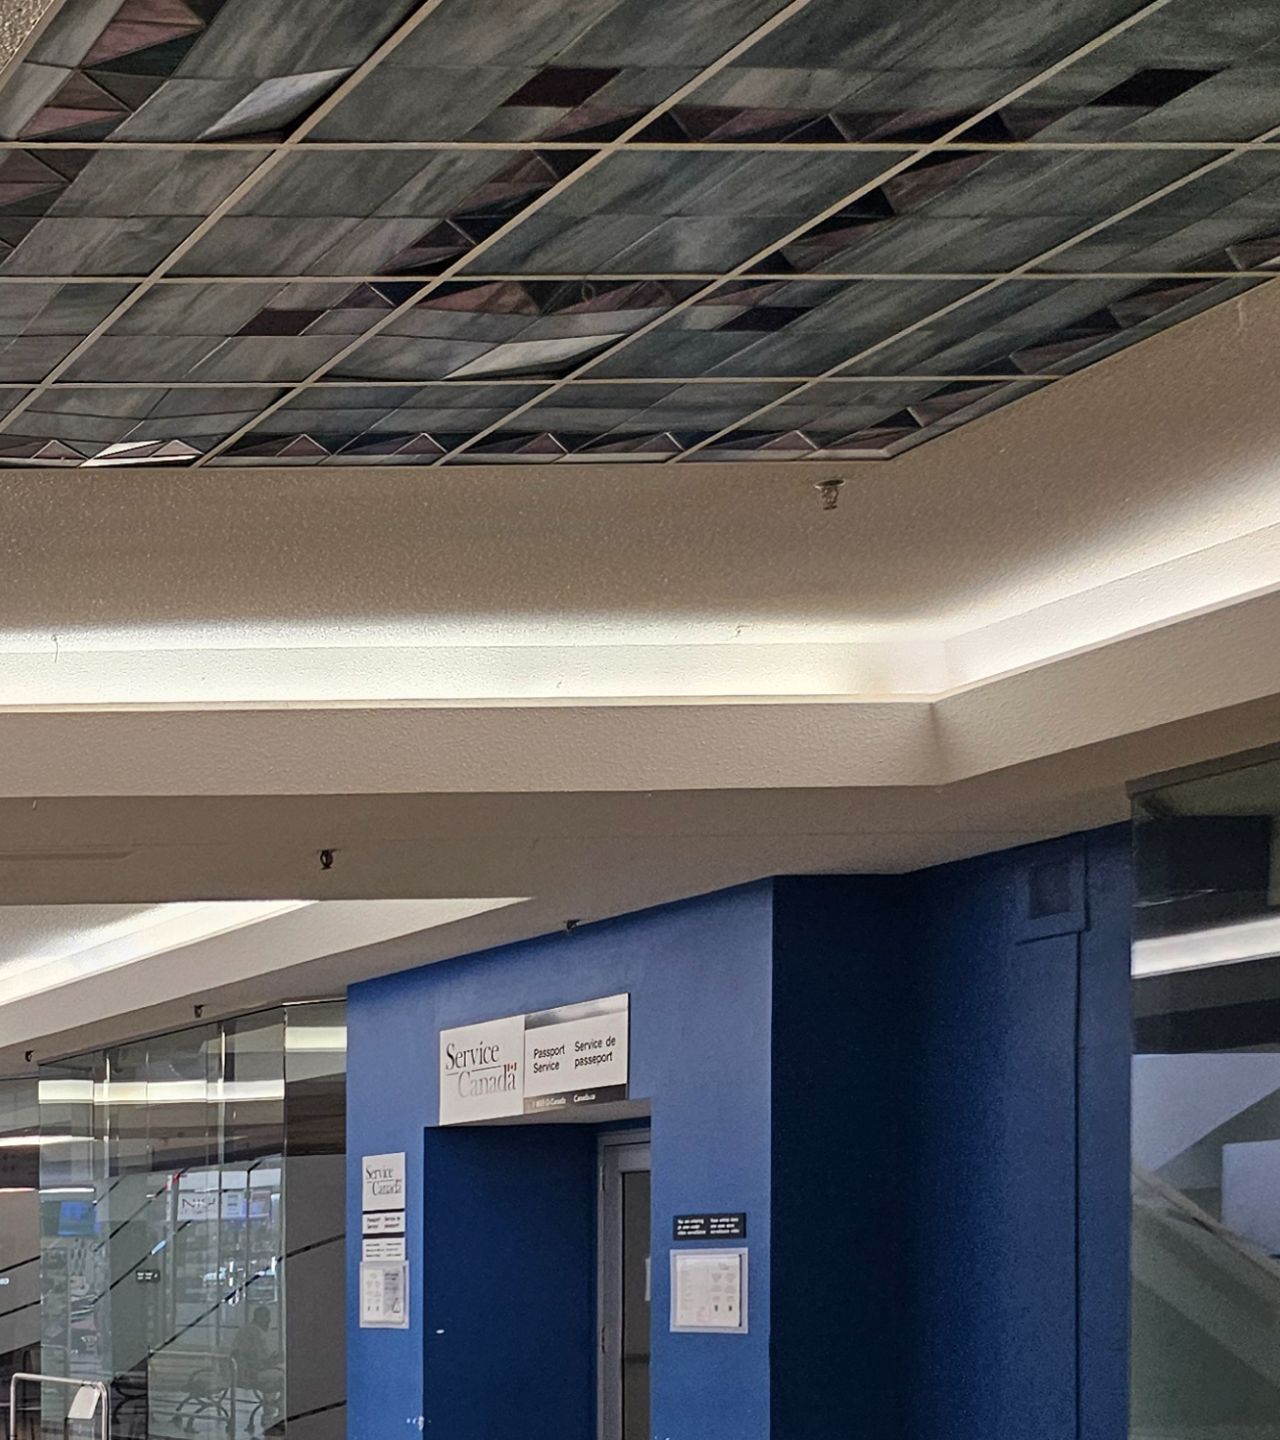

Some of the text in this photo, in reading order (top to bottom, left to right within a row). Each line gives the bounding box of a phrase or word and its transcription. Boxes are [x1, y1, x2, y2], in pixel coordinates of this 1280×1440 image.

[445, 1041, 500, 1070] Service
[533, 1035, 616, 1060] Passport Service de
[574, 1051, 613, 1069] passeport
[533, 1061, 560, 1074] Service
[458, 1063, 517, 1098] Canada
